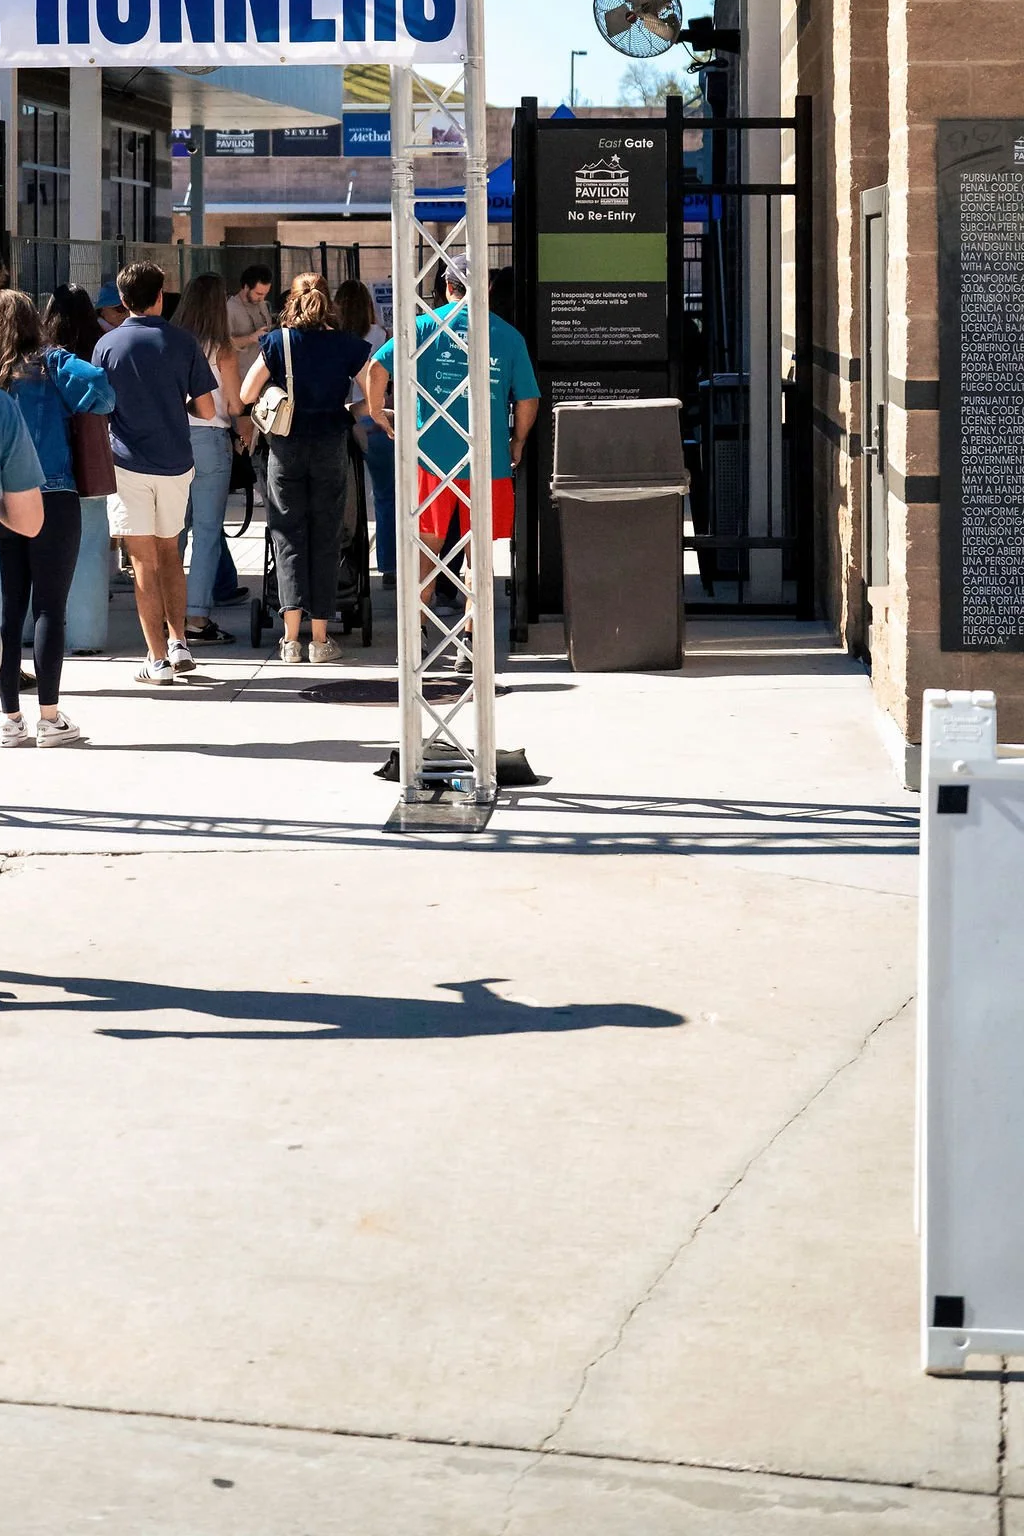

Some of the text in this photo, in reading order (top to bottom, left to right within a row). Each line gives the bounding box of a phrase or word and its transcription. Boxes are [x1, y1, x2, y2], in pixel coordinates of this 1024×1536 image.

[284, 128, 328, 136] SEWELL
[216, 140, 255, 148] PAVILION
[598, 138, 654, 148] East Gate
[1010, 173, 1023, 182] TO
[576, 187, 629, 197] PAVILION
[960, 183, 989, 192] PENAL
[991, 183, 1019, 192] CODE
[960, 193, 996, 202] LICENSE
[960, 203, 1018, 212] CONCEALED
[568, 211, 636, 222] No Re-Entry
[960, 213, 996, 222] PERSON
[960, 223, 1017, 232] SUBCHAPTER
[960, 242, 1012, 252] (HANDGUN
[960, 252, 982, 261] MAY
[984, 252, 1003, 261] NOT
[960, 262, 982, 271] WITH
[984, 262, 992, 271] A
[961, 304, 1003, 312] LICENCIA
[961, 323, 1003, 332] LICENCIA
[961, 343, 1010, 352] GOBIERNO
[961, 353, 986, 362] PARA
[961, 372, 1013, 382] PROPIEDAD
[961, 382, 993, 392] FUEGO
[1011, 396, 1023, 405] TO
[961, 406, 990, 415] PENAL
[992, 406, 1019, 415] CODE
[961, 416, 996, 425] LICENSE
[961, 426, 996, 435] OPENLY
[962, 436, 968, 445] A
[971, 436, 1006, 445] PERSON
[961, 446, 1018, 455] SUBCHAPTER
[961, 466, 1013, 475] (HANDGUN
[962, 476, 983, 484] MAY
[985, 476, 1004, 484] NOT
[962, 485, 983, 494] WITH
[985, 485, 992, 494] A
[961, 495, 1002, 504] CARRIED
[962, 536, 1004, 546] LICENCIA
[962, 546, 994, 556] FUEGO
[962, 556, 983, 566] UNA
[962, 566, 988, 576] BAJO
[990, 566, 999, 576] EL
[963, 586, 1012, 596] GOBIERNO
[963, 596, 988, 605] PARA
[963, 616, 1016, 625] PROPIEDAD
[963, 626, 1017, 635] FUEGO QUE
